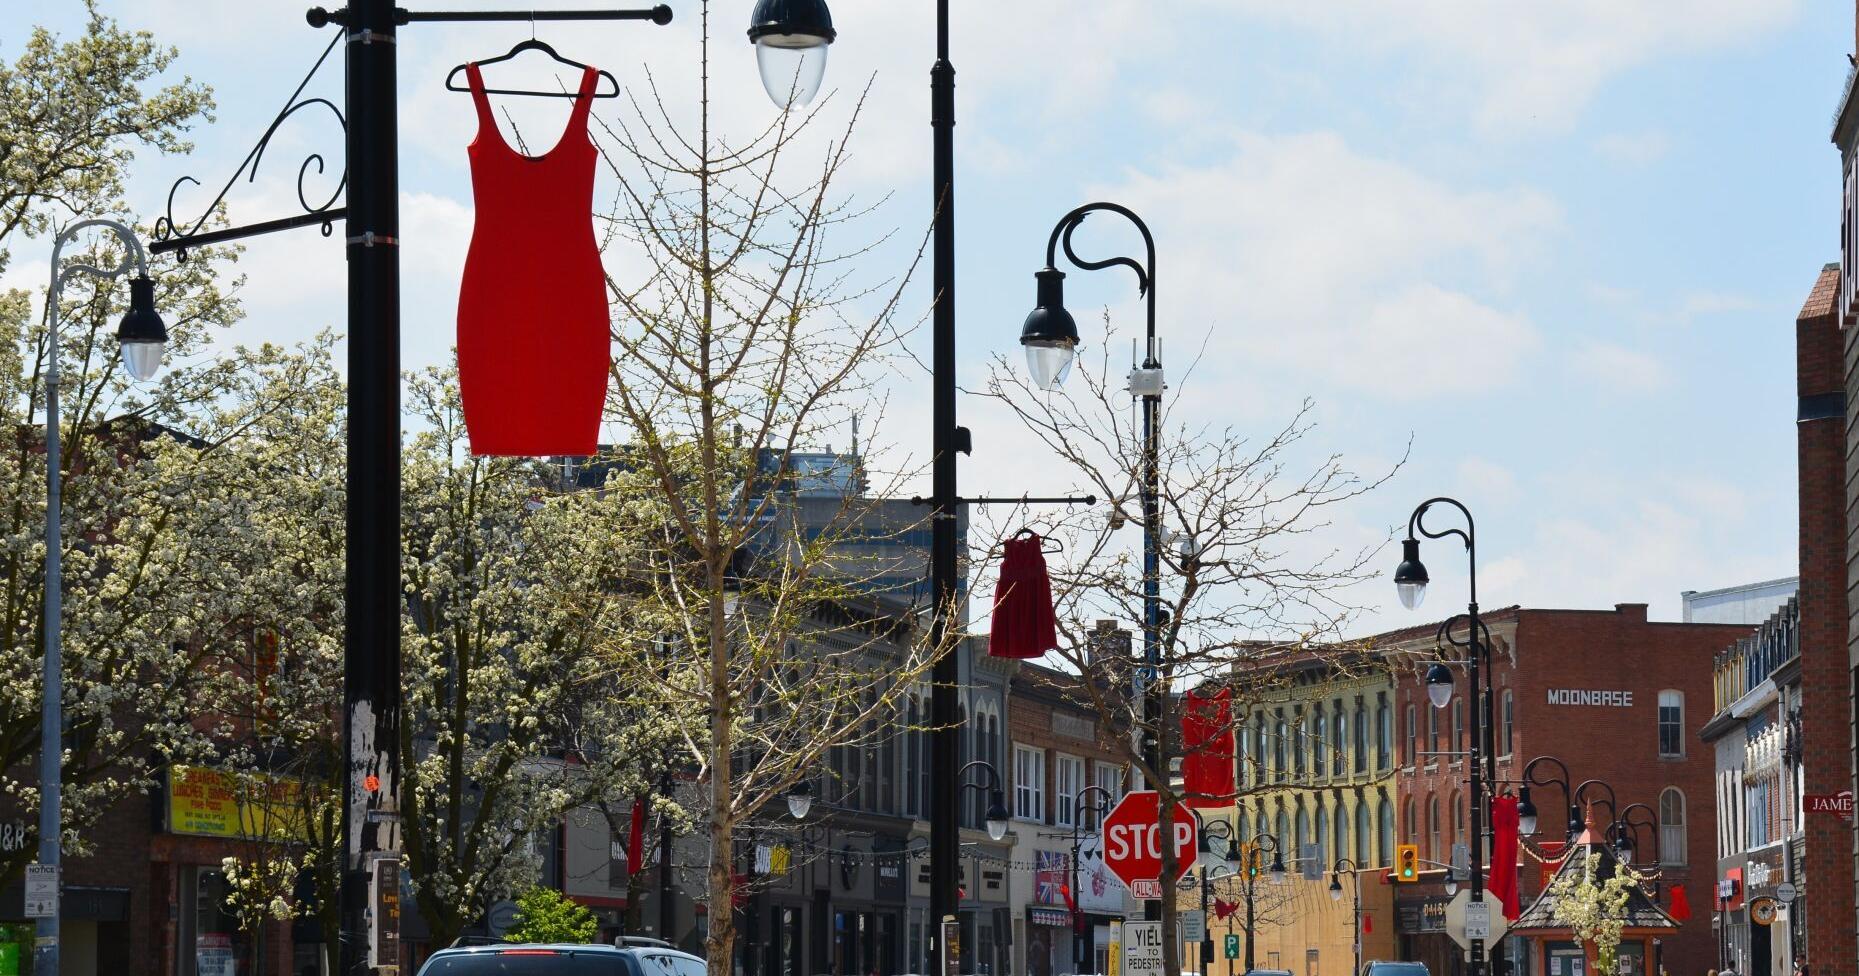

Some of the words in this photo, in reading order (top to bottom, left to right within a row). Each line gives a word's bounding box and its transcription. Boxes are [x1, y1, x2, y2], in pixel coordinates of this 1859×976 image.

[1547, 689, 1633, 707] MOONBASE
[1812, 798, 1853, 811] JAME
[28, 866, 55, 874] NOTICE
[1135, 929, 1162, 946] YIEL
[1227, 936, 1236, 949] P
[1128, 958, 1163, 970] PEDESTRI
